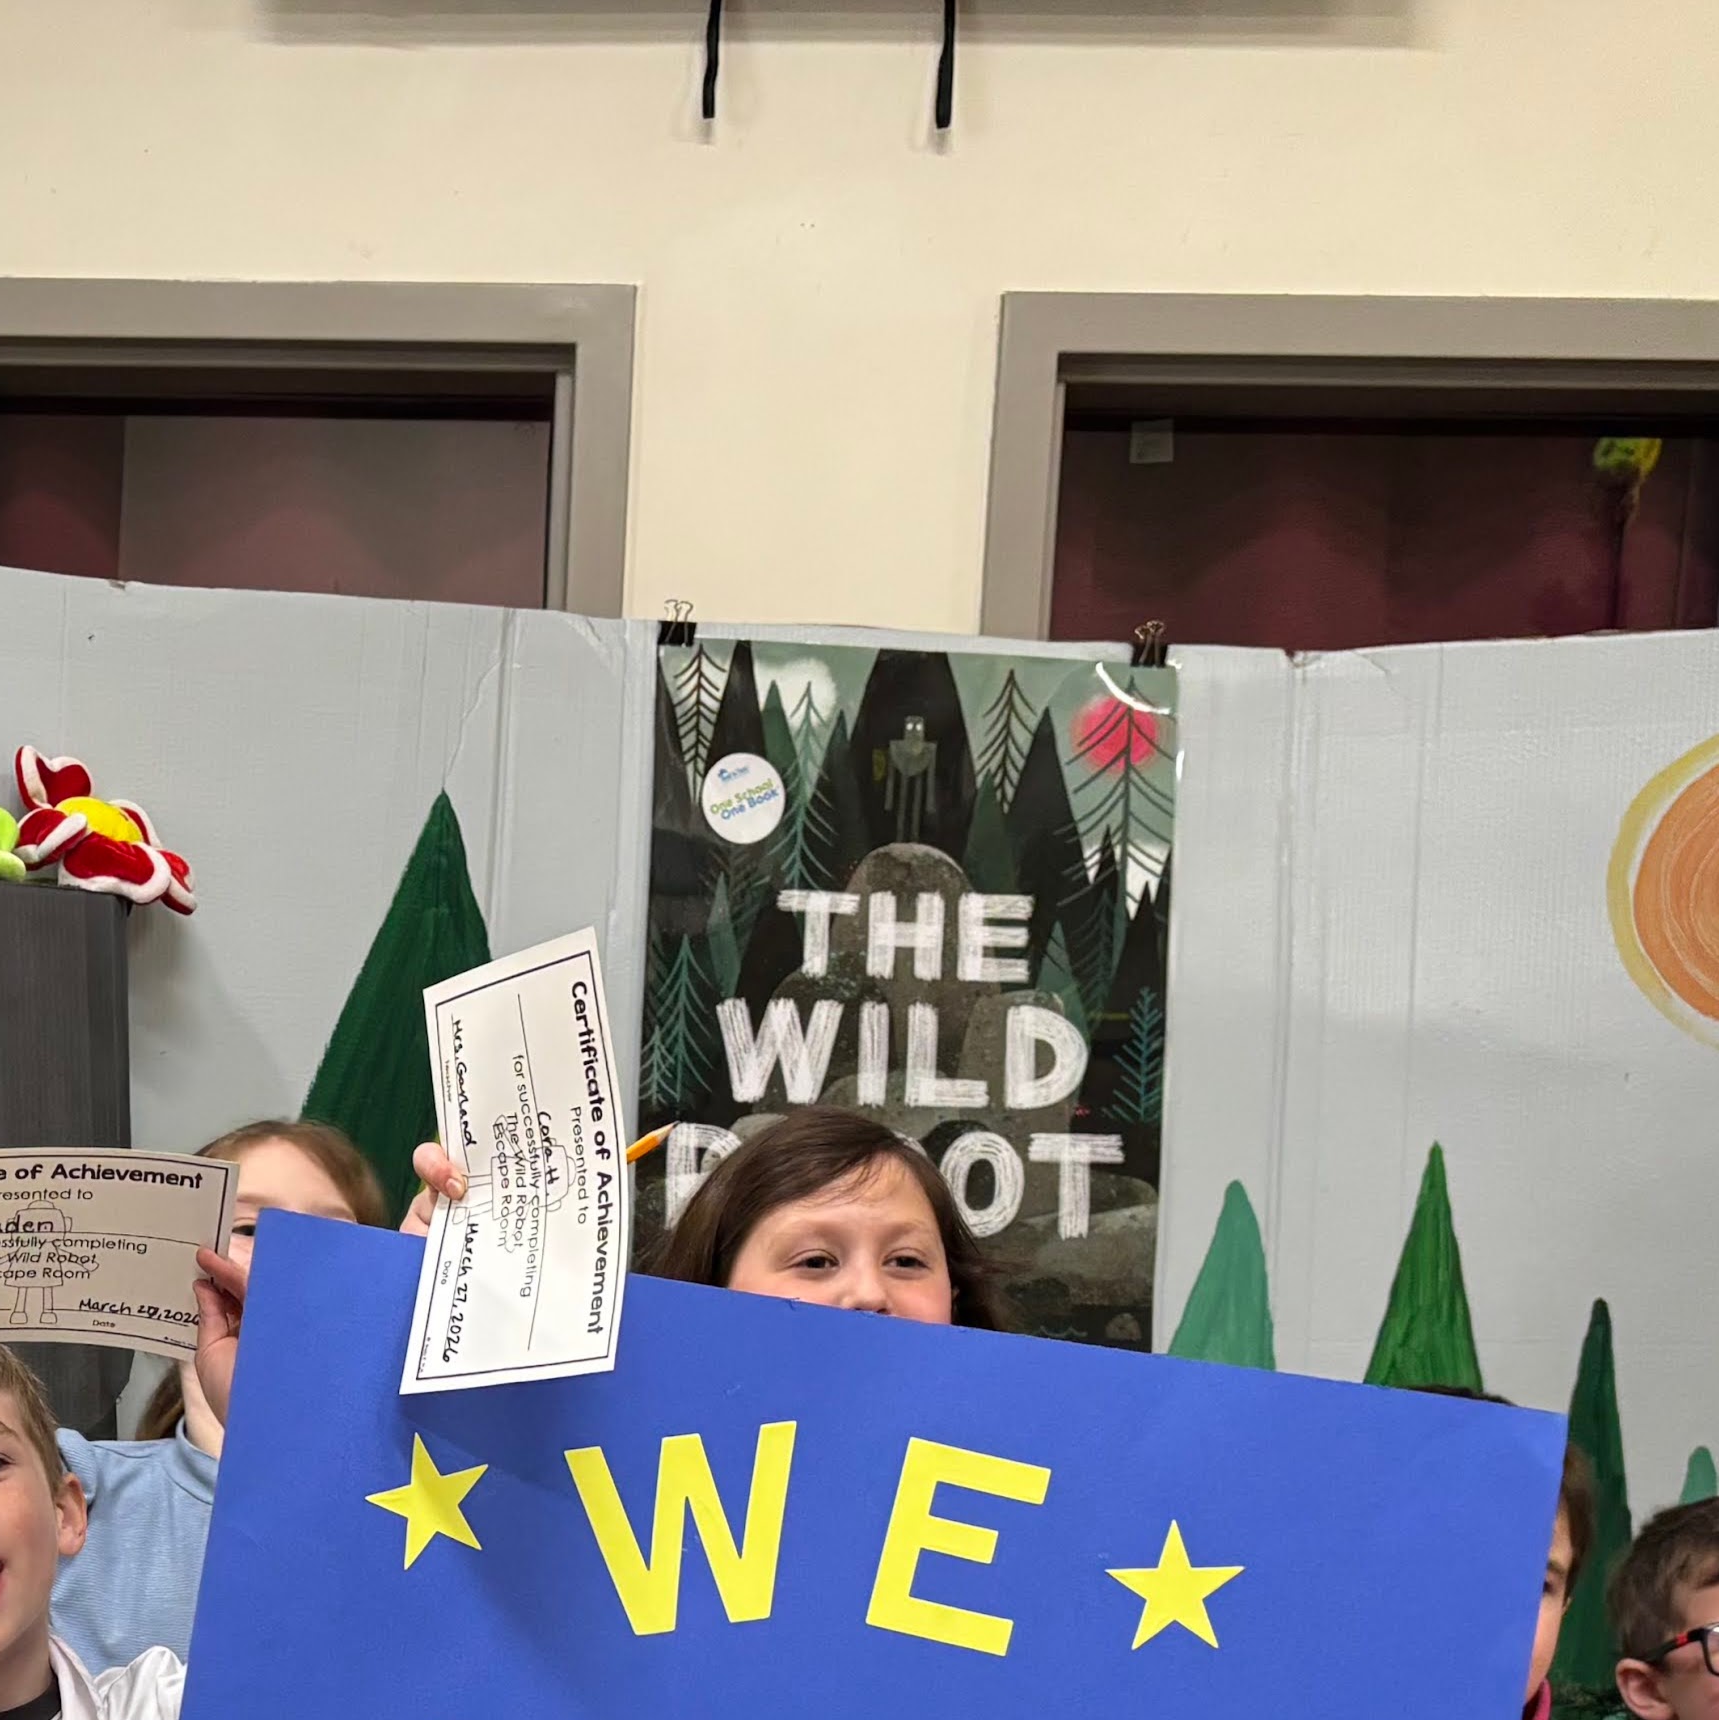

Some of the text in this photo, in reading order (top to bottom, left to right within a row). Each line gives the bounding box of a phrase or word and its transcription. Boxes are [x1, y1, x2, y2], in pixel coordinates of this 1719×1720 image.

[776, 888, 1035, 984] THE
[715, 997, 1088, 1109] WILD
[456, 1061, 477, 1147] Garland
[15, 1163, 43, 1180] of
[51, 1163, 203, 1189] Achievement
[77, 1188, 94, 1200] to
[493, 1122, 512, 1247] Escape Room
[507, 1112, 527, 1248] The Wild Robot
[512, 1054, 542, 1298] for successfully completing
[572, 981, 613, 1334] Certificate of Achievement
[664, 1121, 1125, 1241] ROT
[8, 1251, 41, 1263] Wild
[46, 1252, 97, 1265] Robot
[51, 1236, 148, 1255] completing
[577, 1206, 588, 1224] to
[42, 1267, 91, 1279] Room
[79, 1298, 132, 1316] March
[442, 1222, 479, 1363] March 27, 2026
[564, 1420, 1053, 1658] WE
